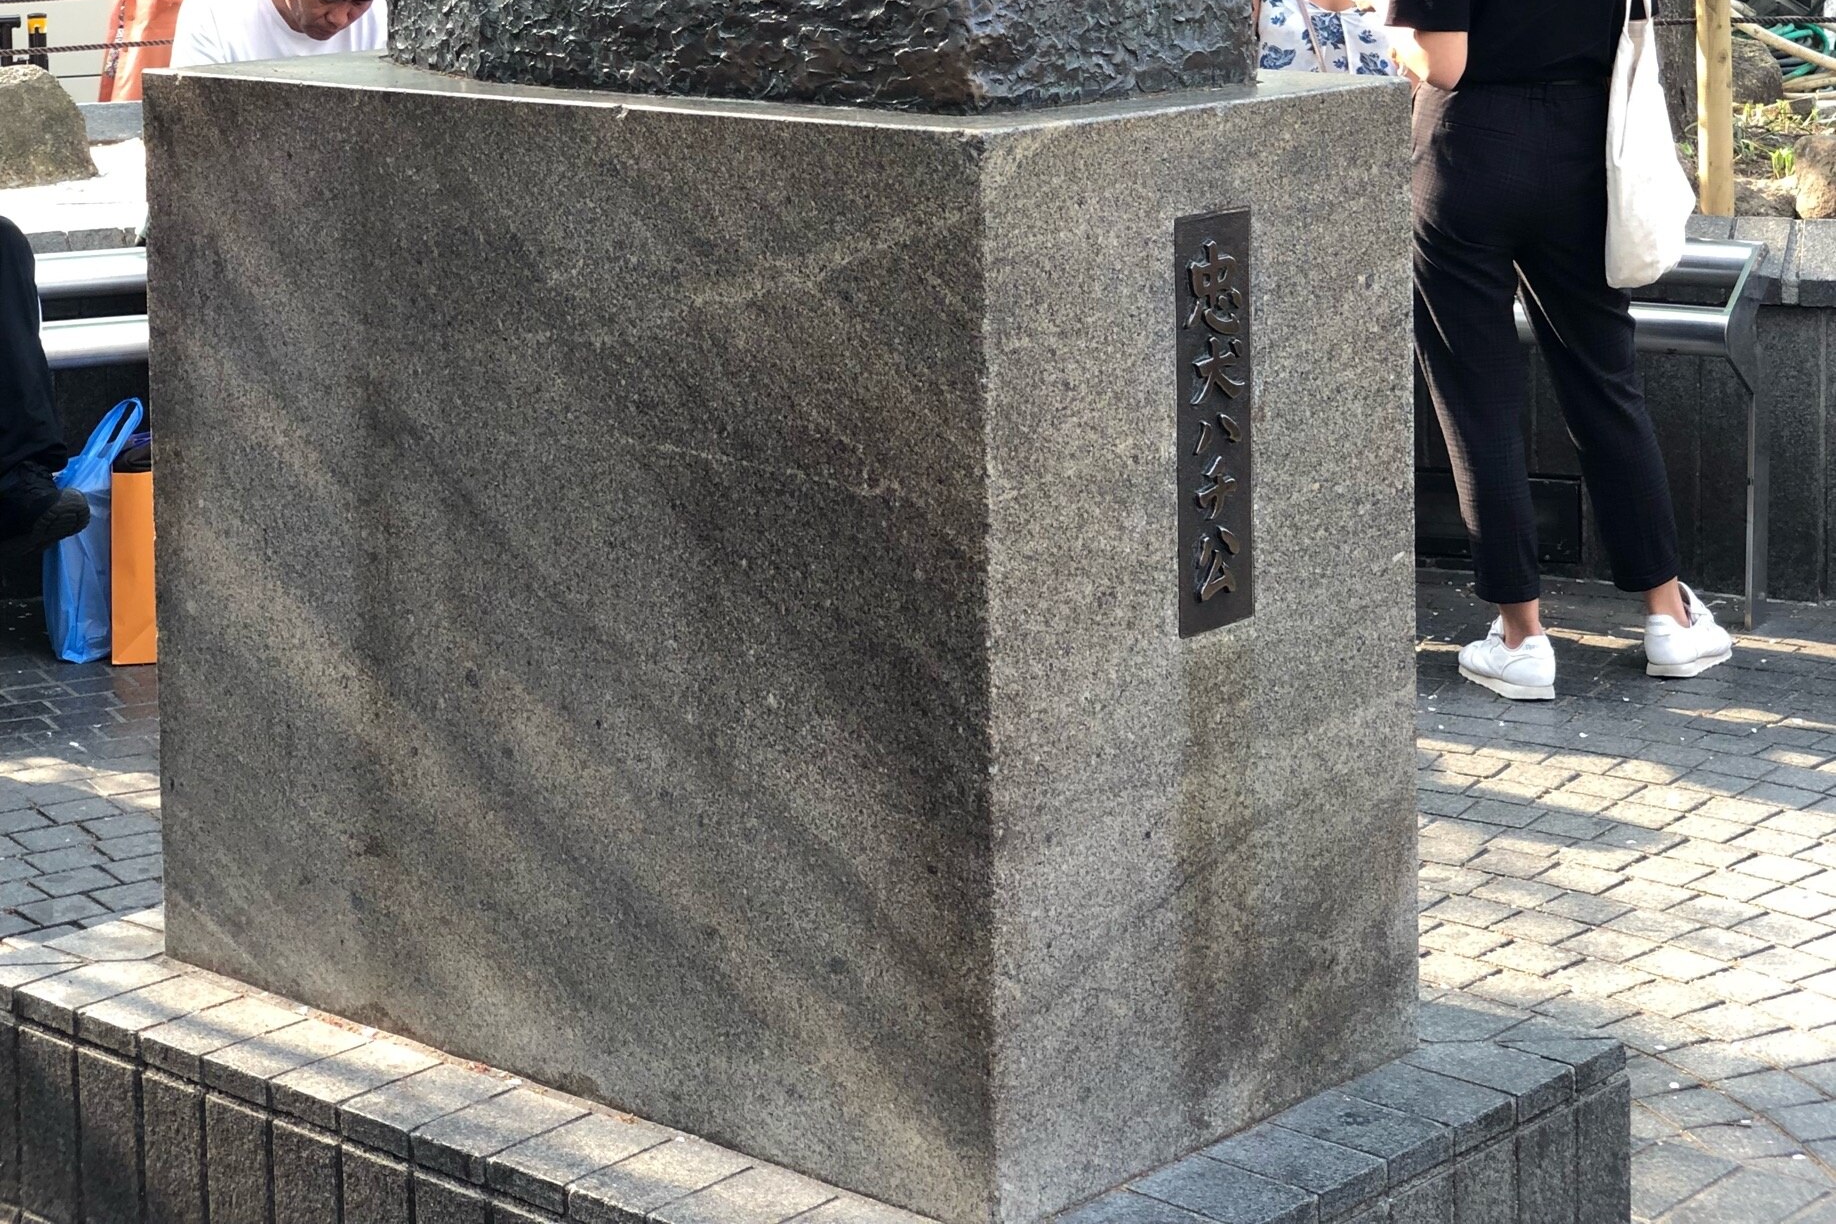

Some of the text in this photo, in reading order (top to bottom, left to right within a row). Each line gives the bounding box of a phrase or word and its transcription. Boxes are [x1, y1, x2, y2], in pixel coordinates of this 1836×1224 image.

[1182, 238, 1245, 603] 忠犬ハチ公
